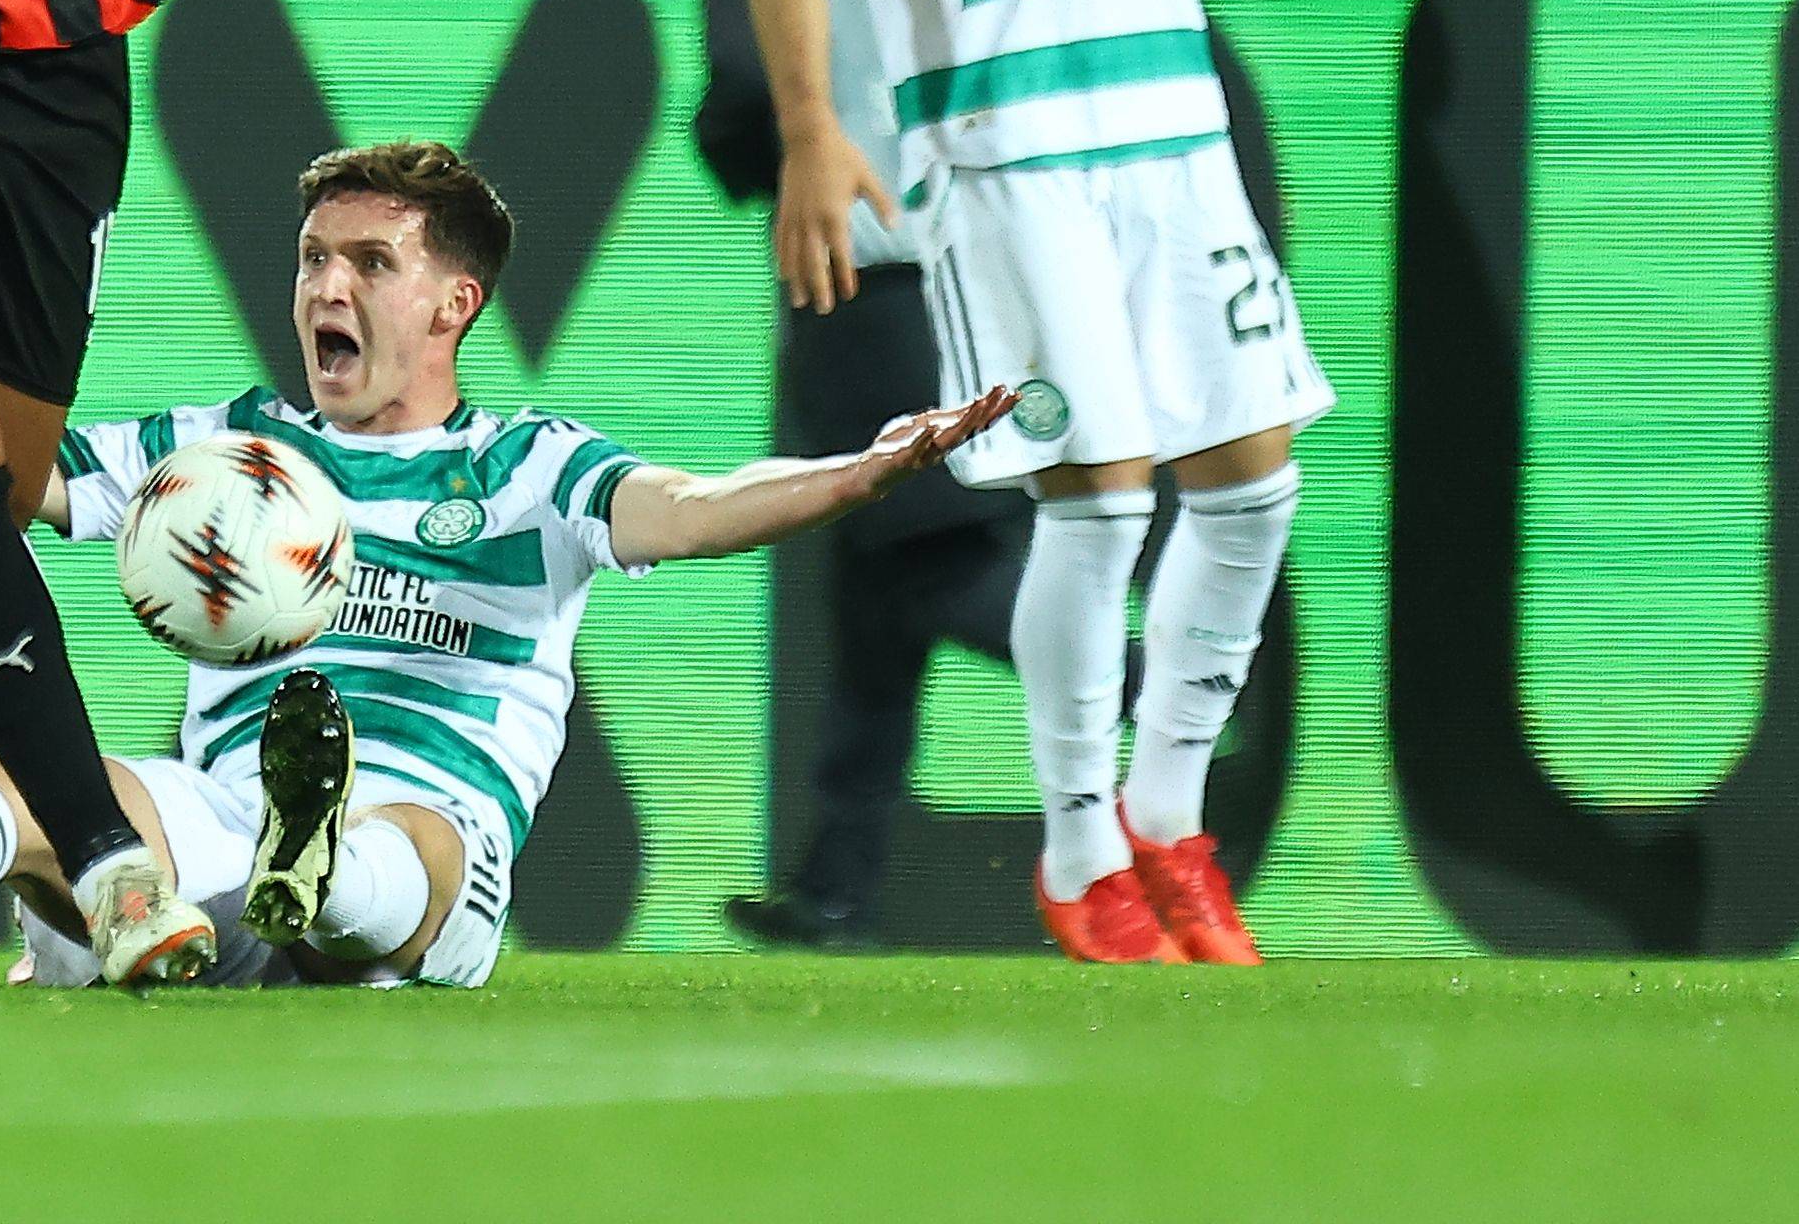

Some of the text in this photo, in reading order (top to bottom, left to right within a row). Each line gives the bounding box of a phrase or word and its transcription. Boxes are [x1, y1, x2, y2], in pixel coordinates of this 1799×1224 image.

[345, 565, 432, 605] LTIC FC
[326, 601, 470, 654] UNDATION
